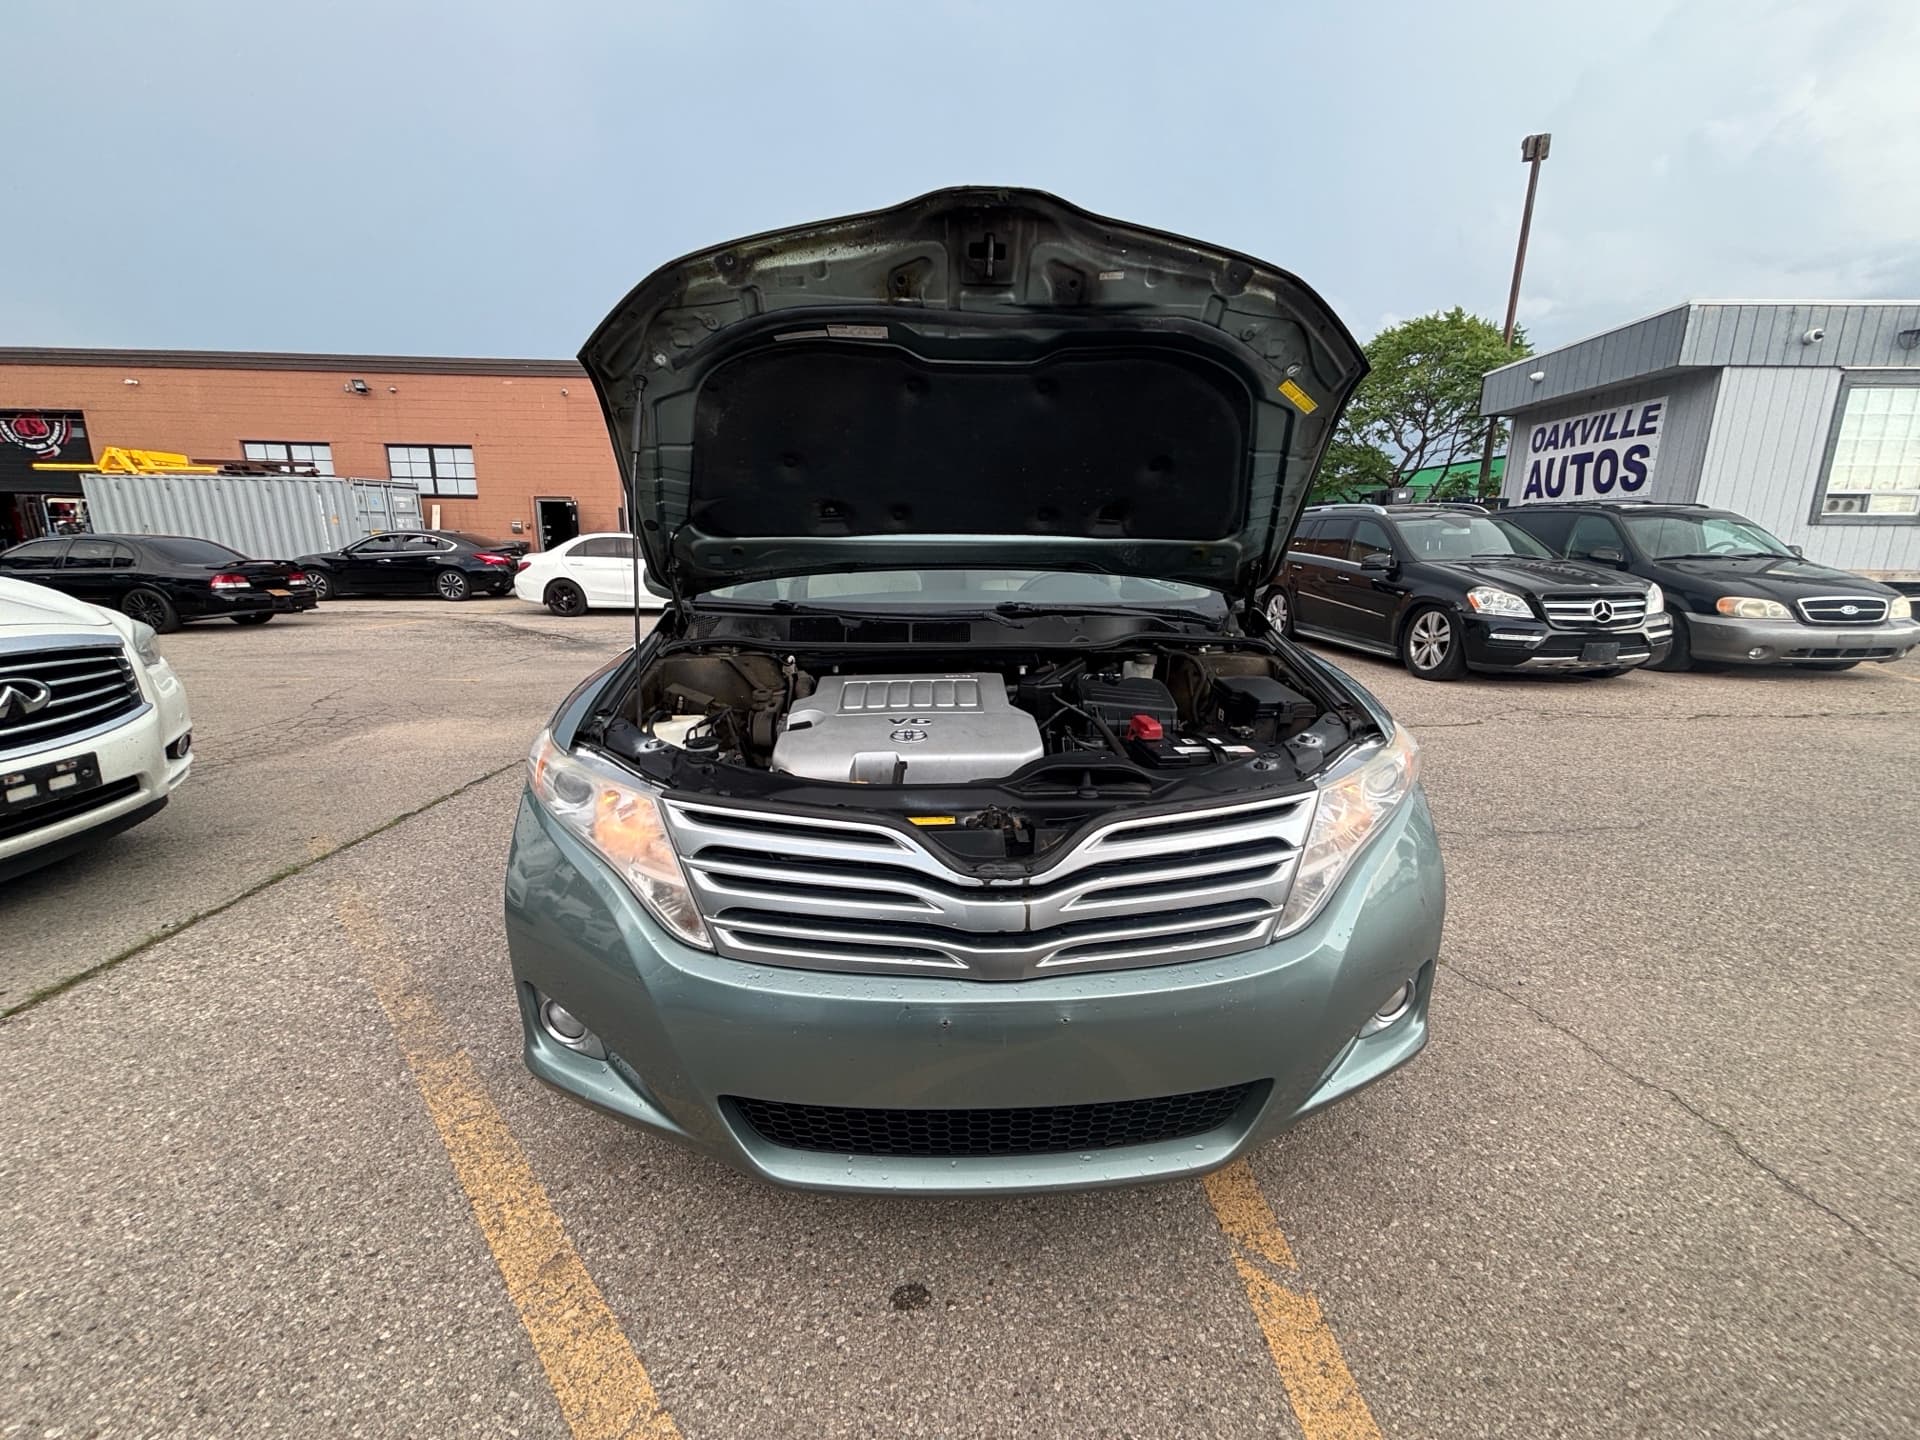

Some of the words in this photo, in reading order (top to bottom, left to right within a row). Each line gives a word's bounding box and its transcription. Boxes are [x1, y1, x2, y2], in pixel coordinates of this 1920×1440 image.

[1531, 403, 1662, 453] OAKVILLE
[1523, 444, 1650, 500] AUTOS
[887, 718, 931, 726] V6
